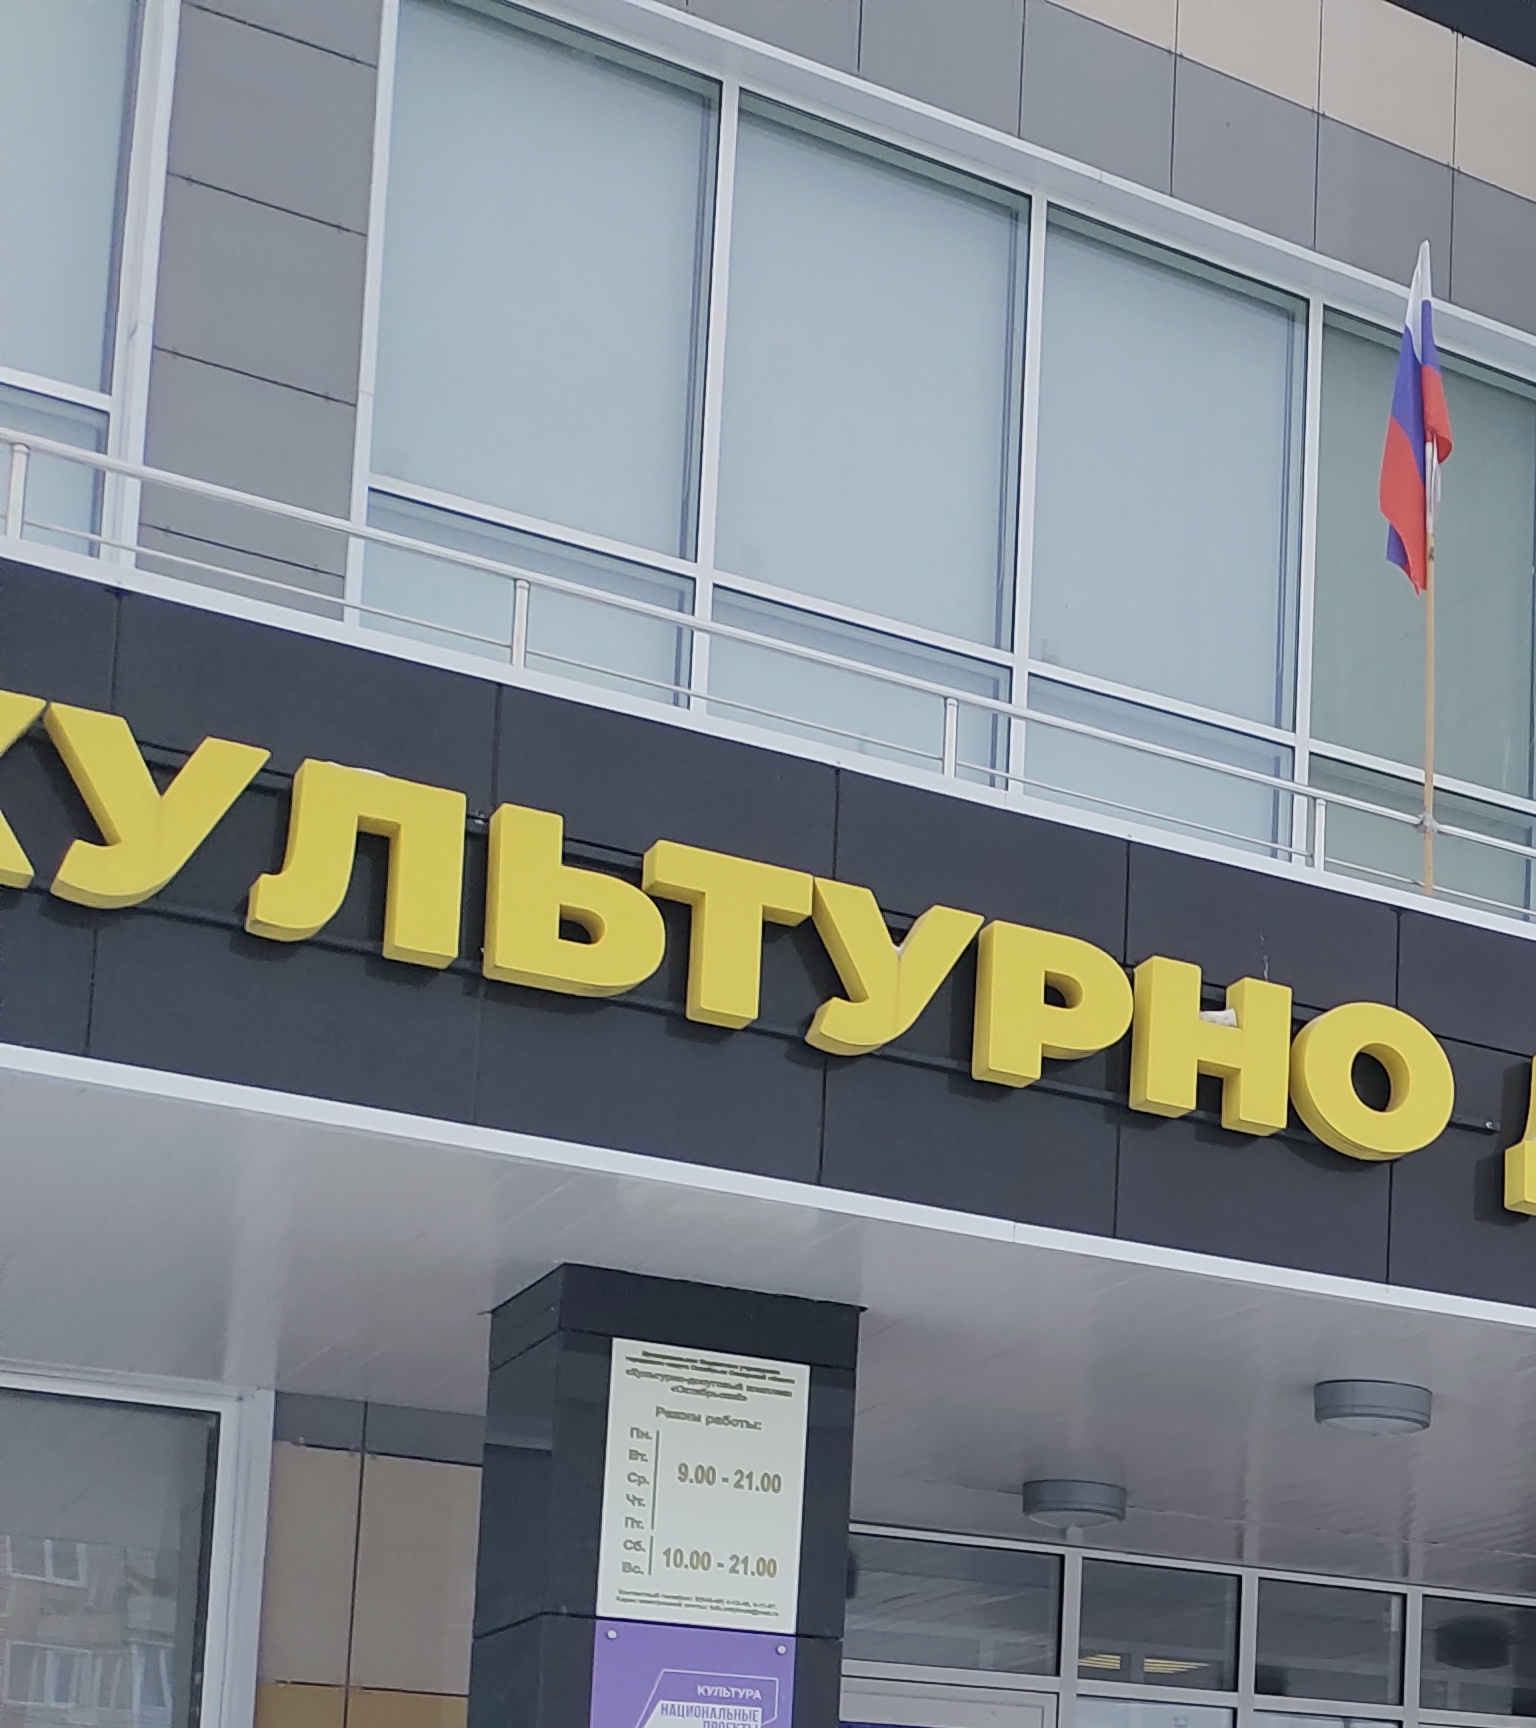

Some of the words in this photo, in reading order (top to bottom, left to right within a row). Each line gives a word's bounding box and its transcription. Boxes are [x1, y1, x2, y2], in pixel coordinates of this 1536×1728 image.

[677, 1463, 717, 1486] 9.00
[733, 1468, 782, 1494] 21.00
[662, 1547, 712, 1571] 10.00
[728, 1554, 777, 1578] 21.00
[697, 1685, 762, 1700] КУЛЬТУРА
[660, 1703, 759, 1722] НАЦИОНАЛЬНЫЕ
